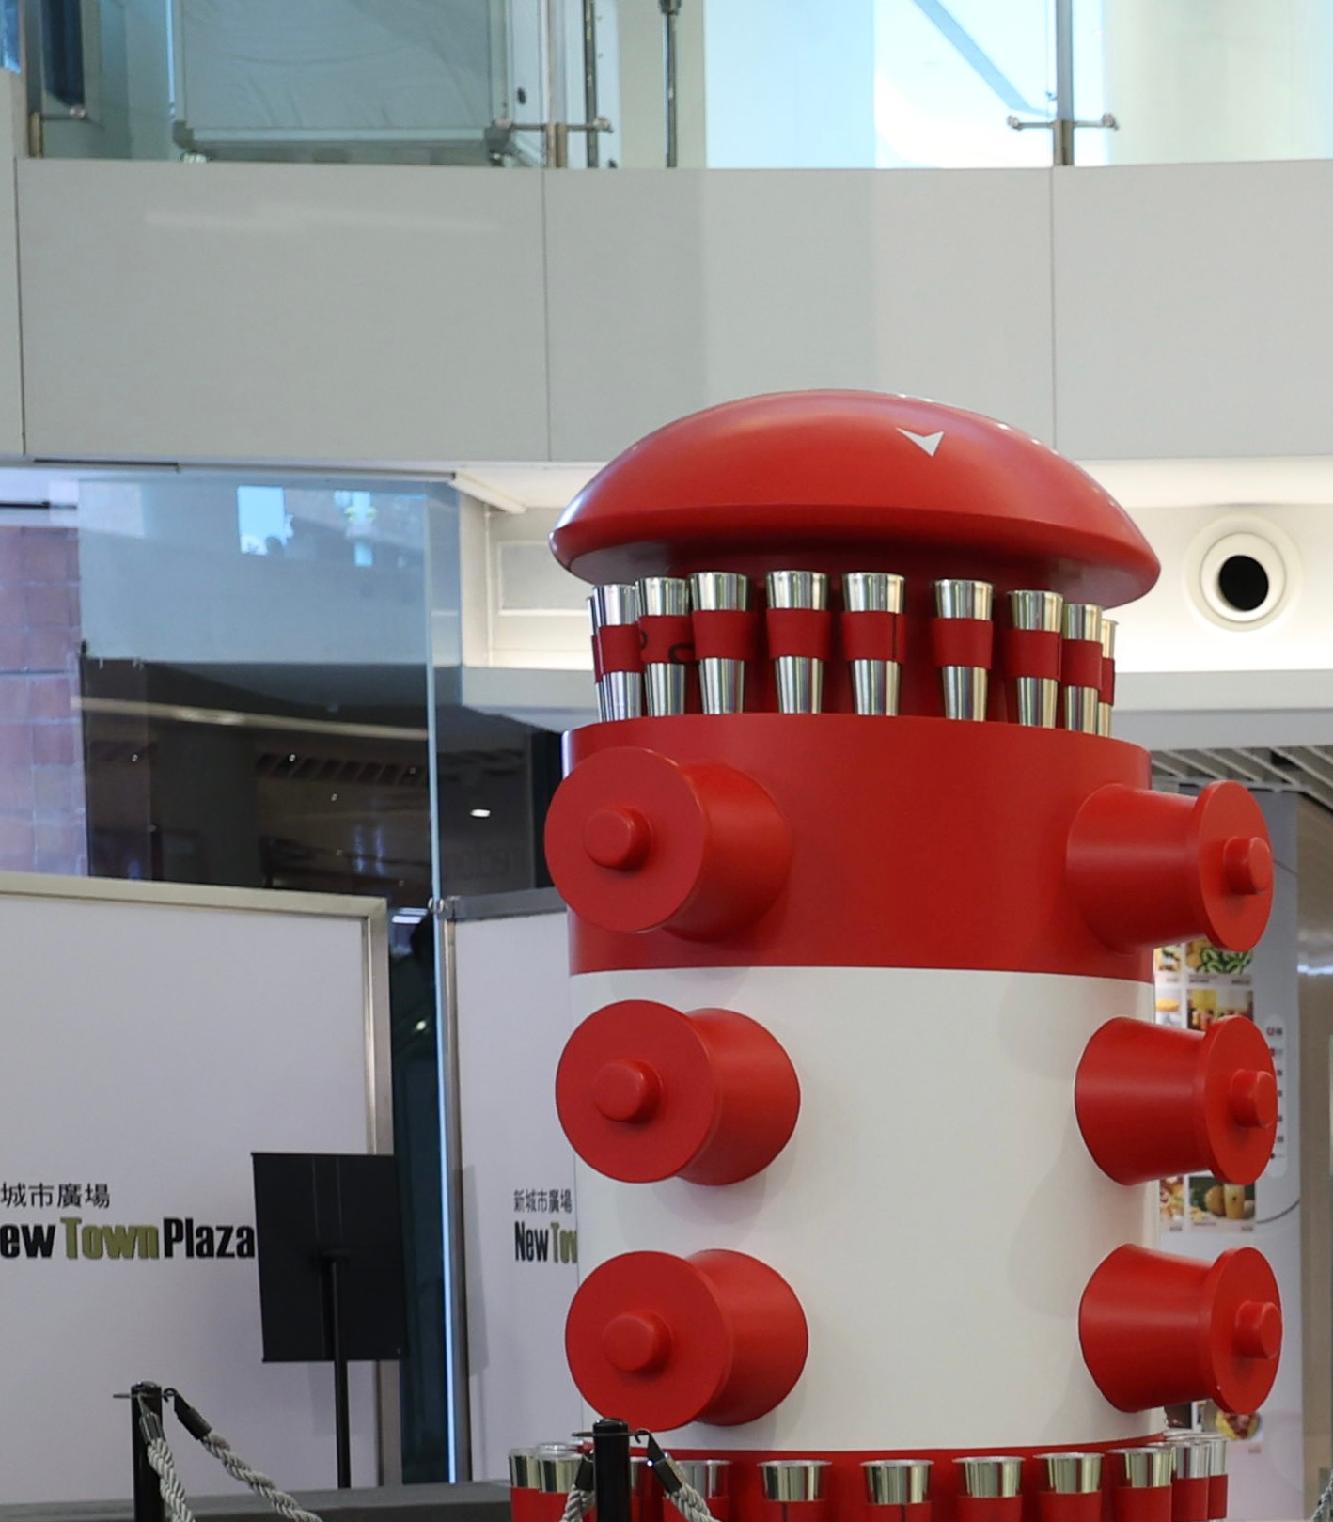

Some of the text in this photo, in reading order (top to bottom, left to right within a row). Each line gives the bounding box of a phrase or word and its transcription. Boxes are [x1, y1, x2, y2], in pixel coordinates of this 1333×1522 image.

[0, 1183, 110, 1208] 城市廣場
[0, 1216, 256, 1260] ew Town Plaza
[514, 1220, 579, 1263] New Tow
